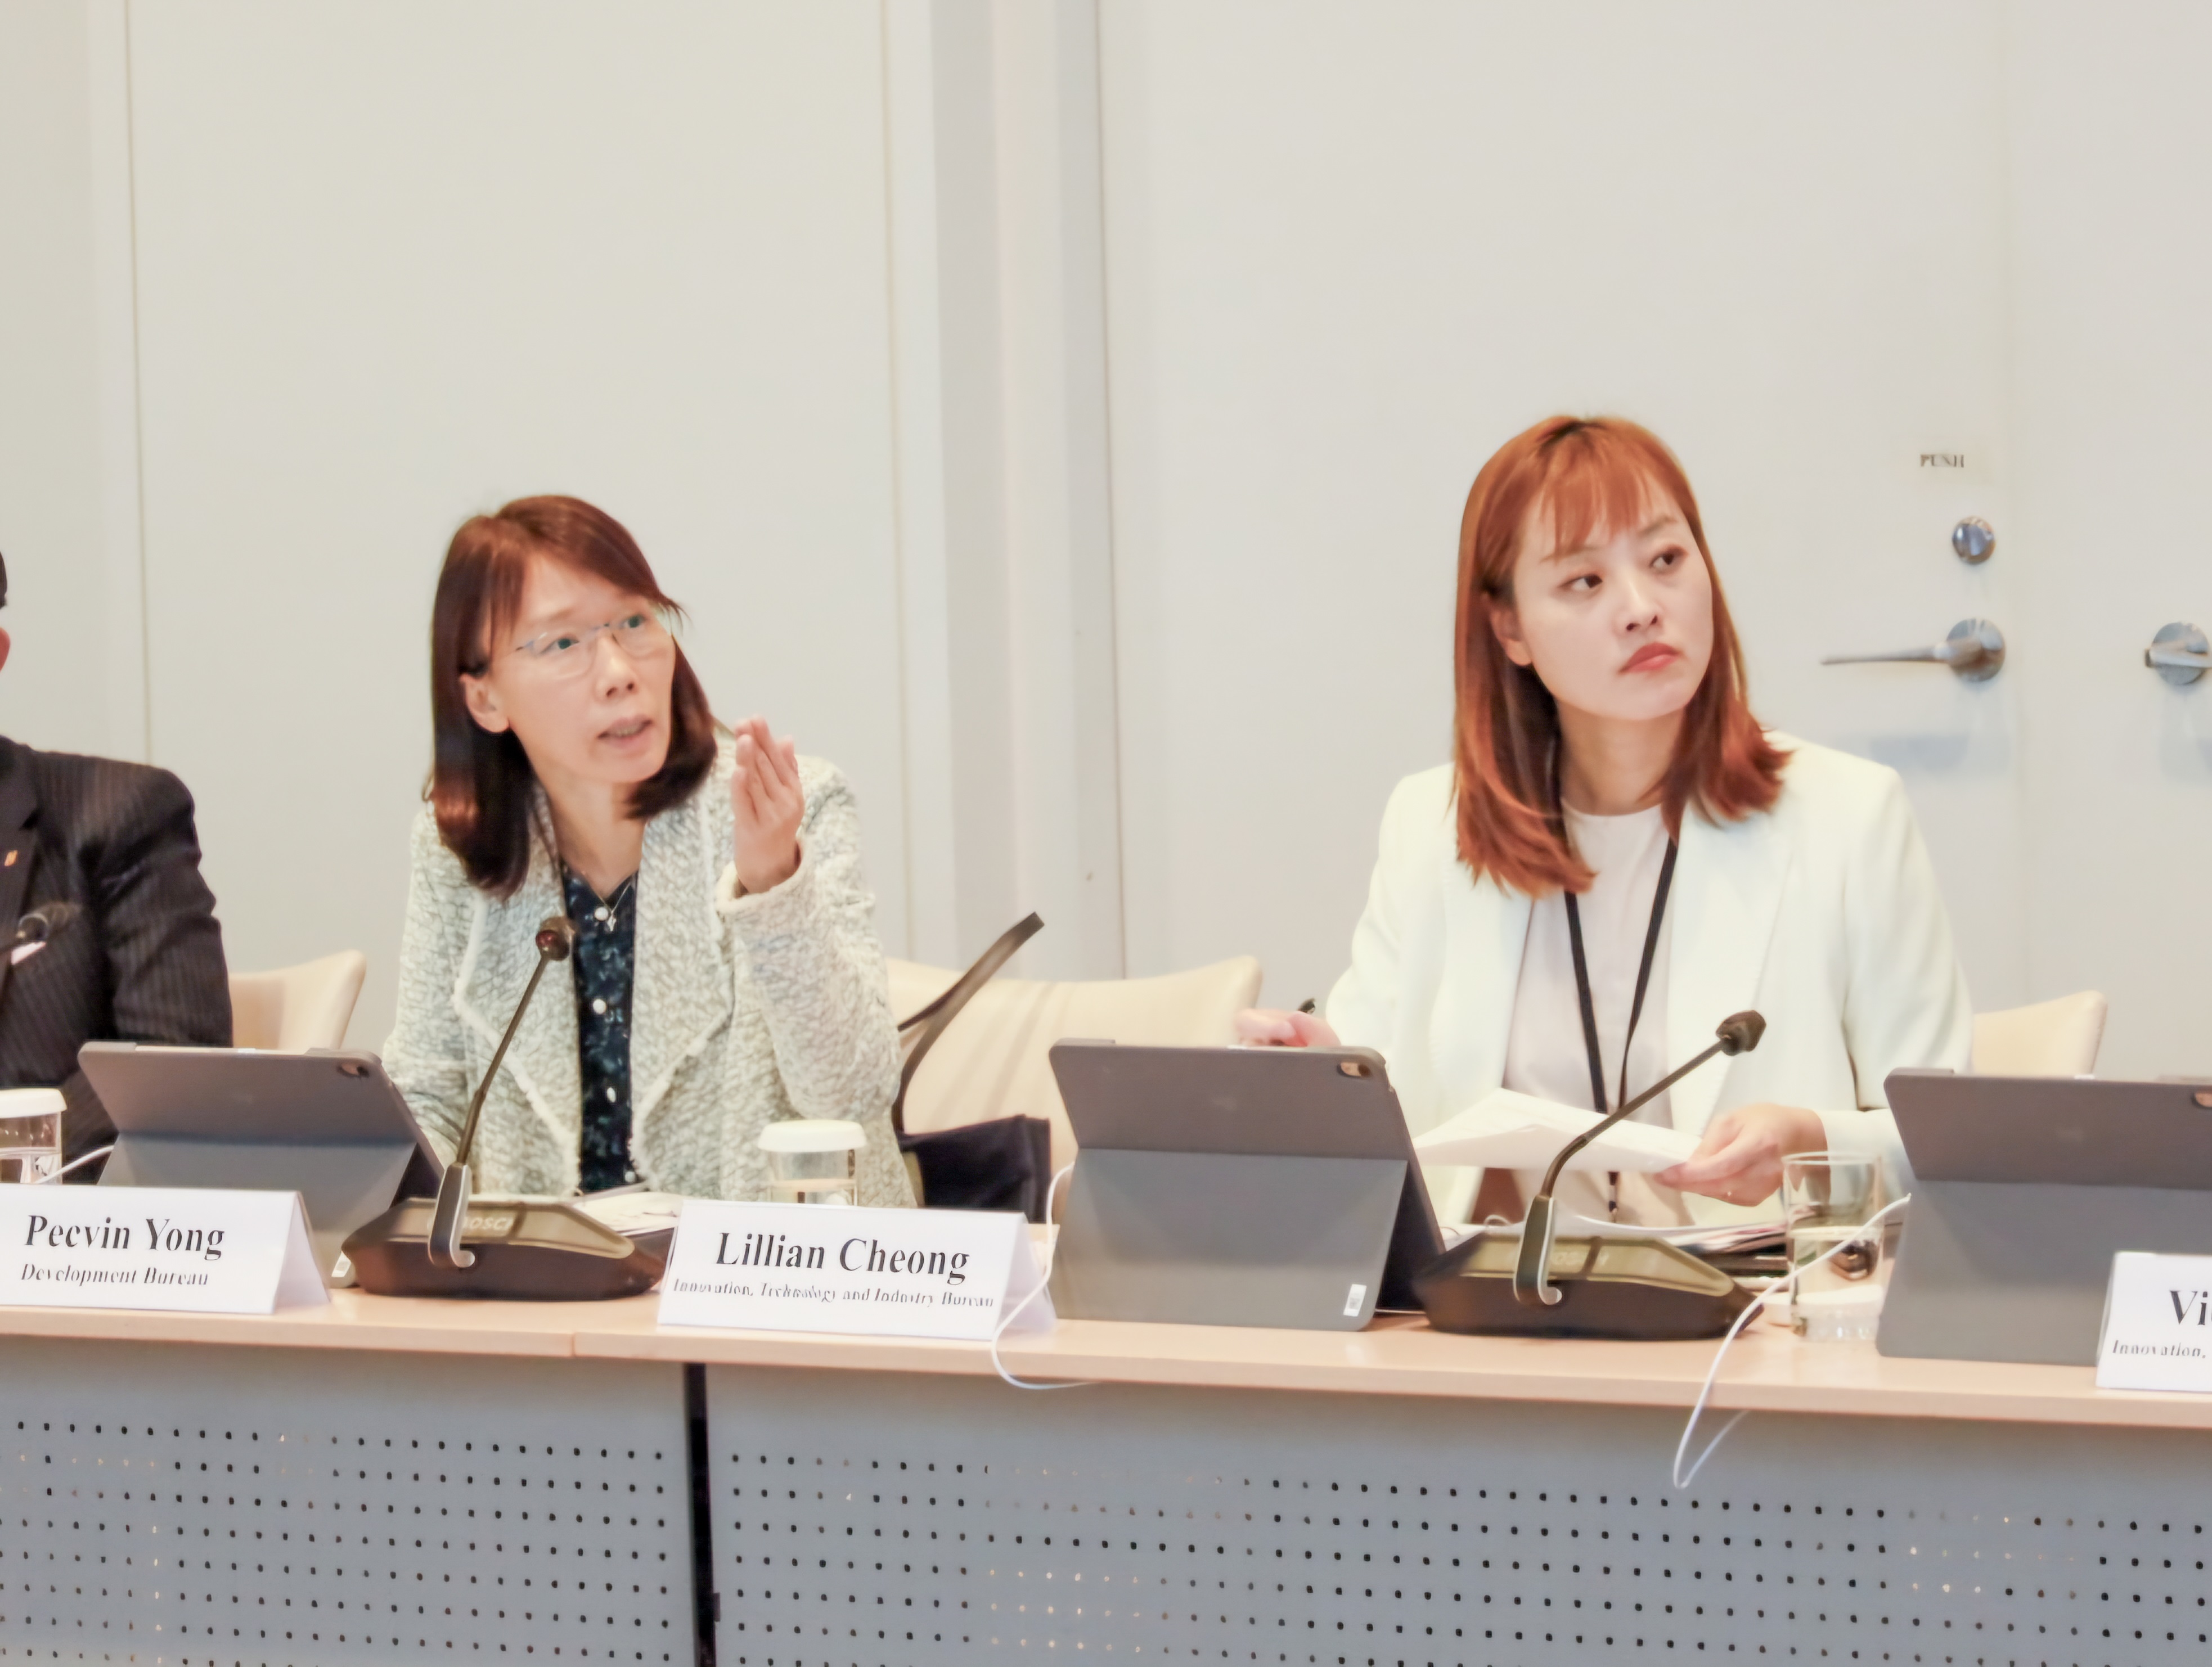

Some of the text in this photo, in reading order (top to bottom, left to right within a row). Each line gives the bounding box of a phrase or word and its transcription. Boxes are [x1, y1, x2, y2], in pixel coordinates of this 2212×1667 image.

[146, 1218, 225, 1261] Yong
[21, 1263, 208, 1287] Development Bureau
[716, 1232, 970, 1286] Lillian Cheong
[843, 1288, 871, 1301] and
[2169, 1290, 2212, 1326] Vi
